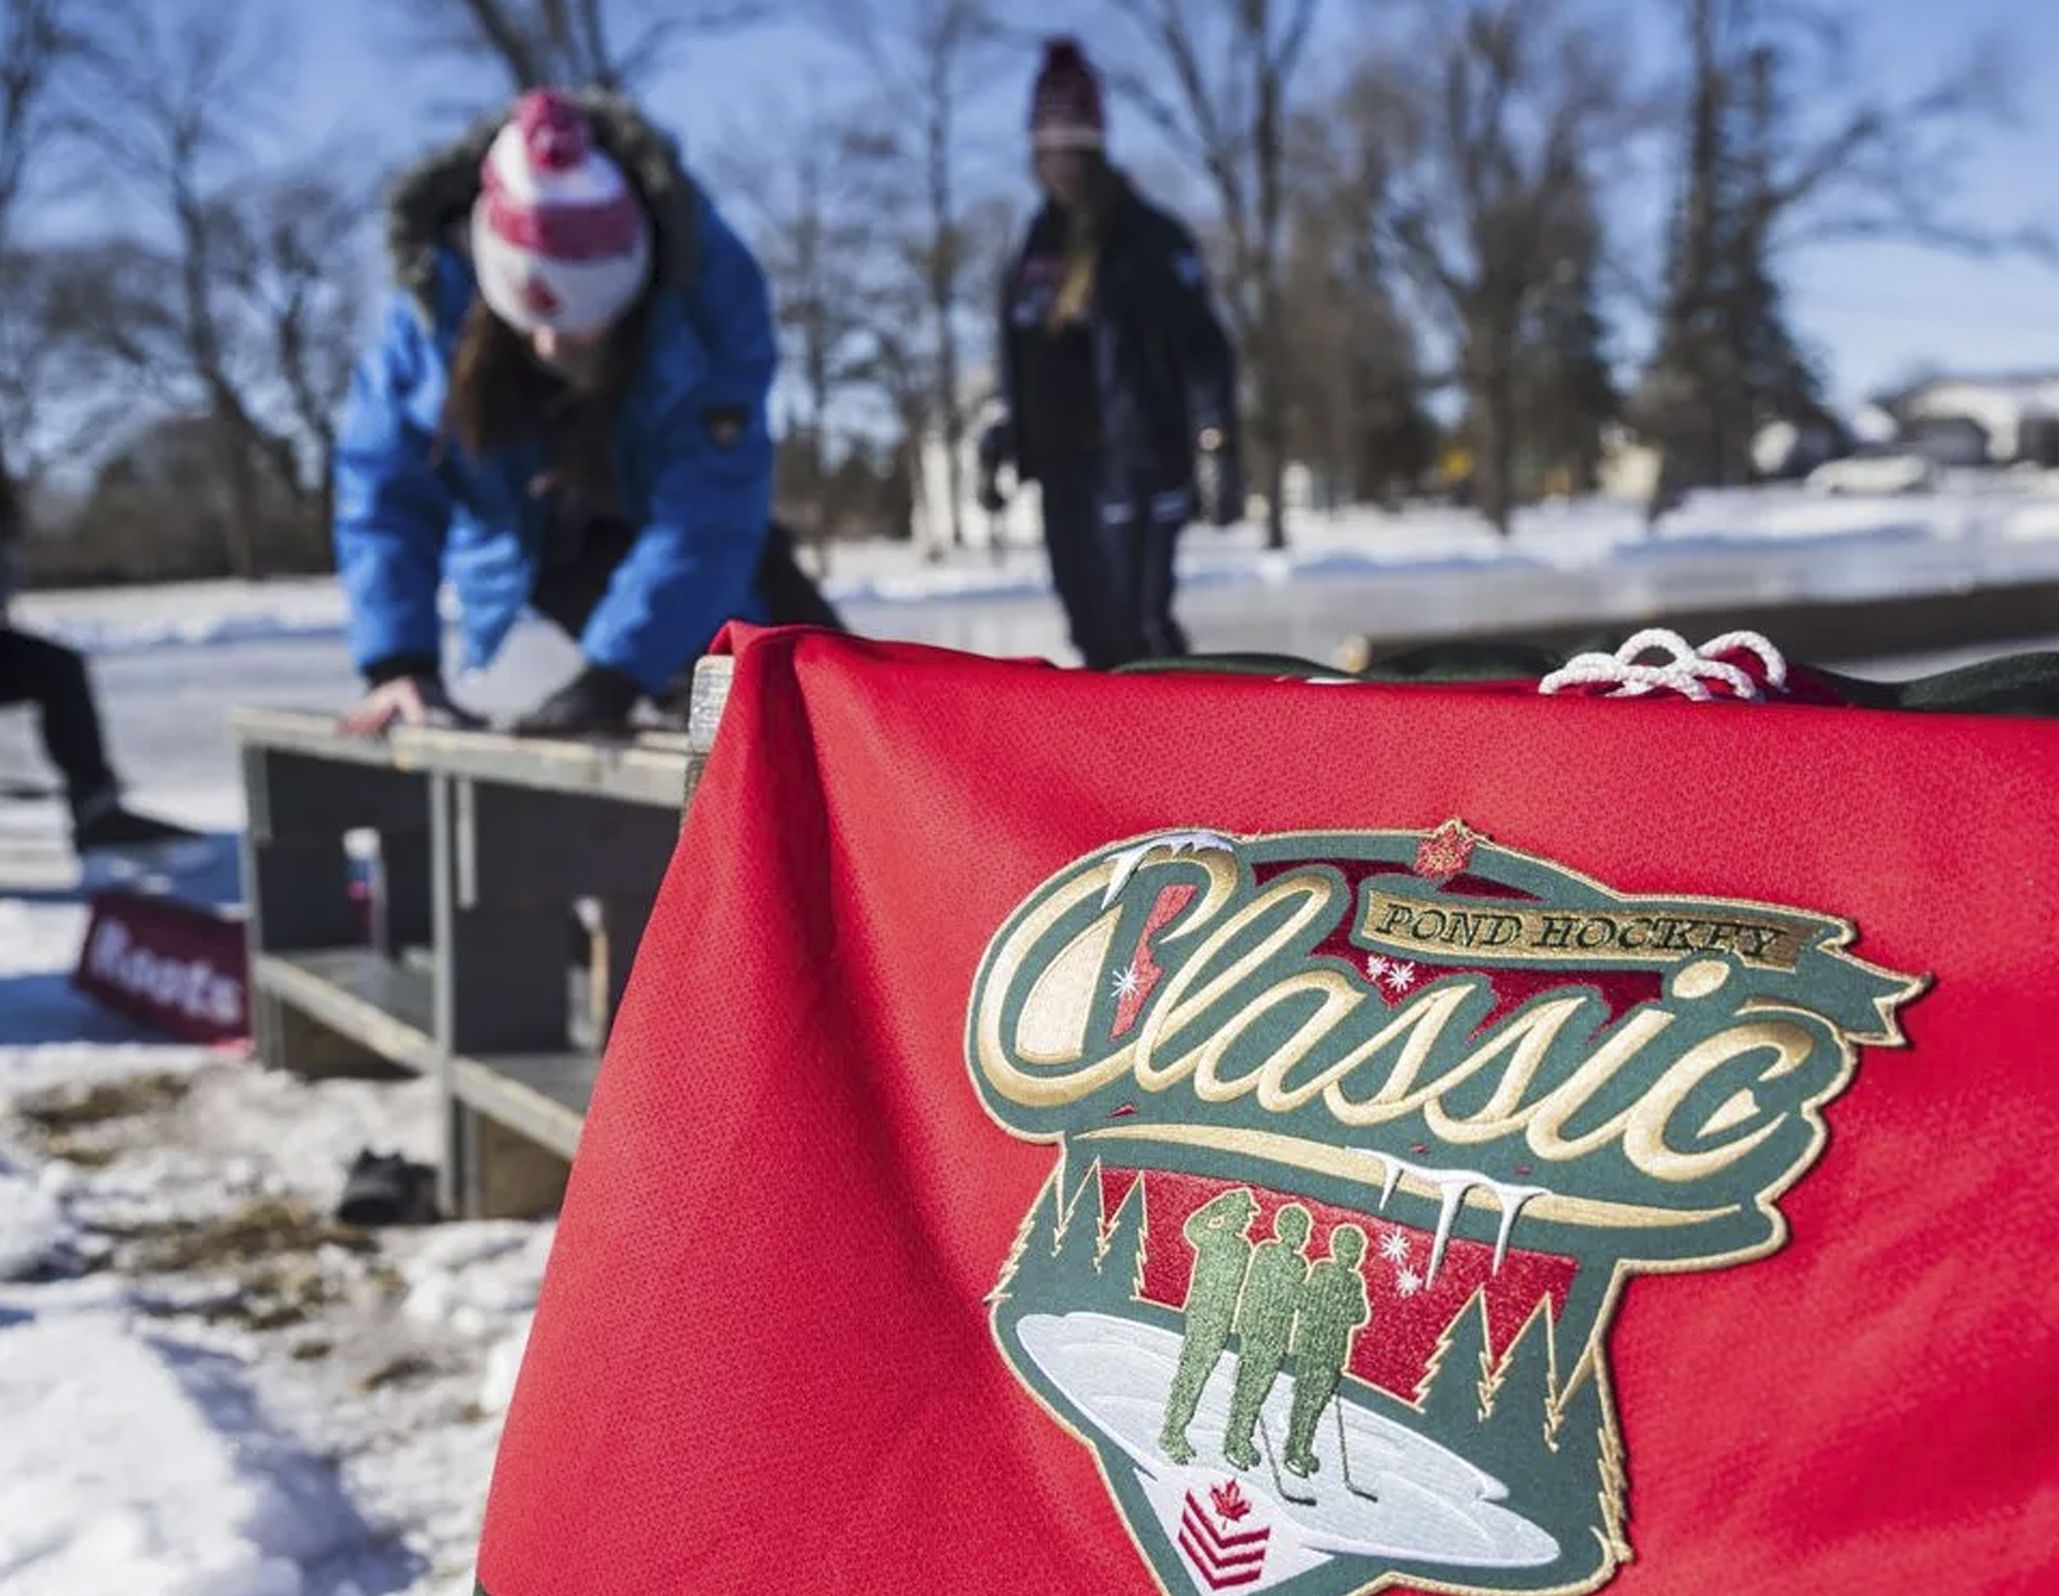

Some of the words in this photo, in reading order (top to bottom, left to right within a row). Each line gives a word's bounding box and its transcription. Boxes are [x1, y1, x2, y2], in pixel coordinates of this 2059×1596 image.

[91, 917, 240, 1026] Roots
[1375, 902, 1523, 947] POND
[1531, 915, 1788, 956] HOCKEY
[976, 840, 1815, 1181] Classic
